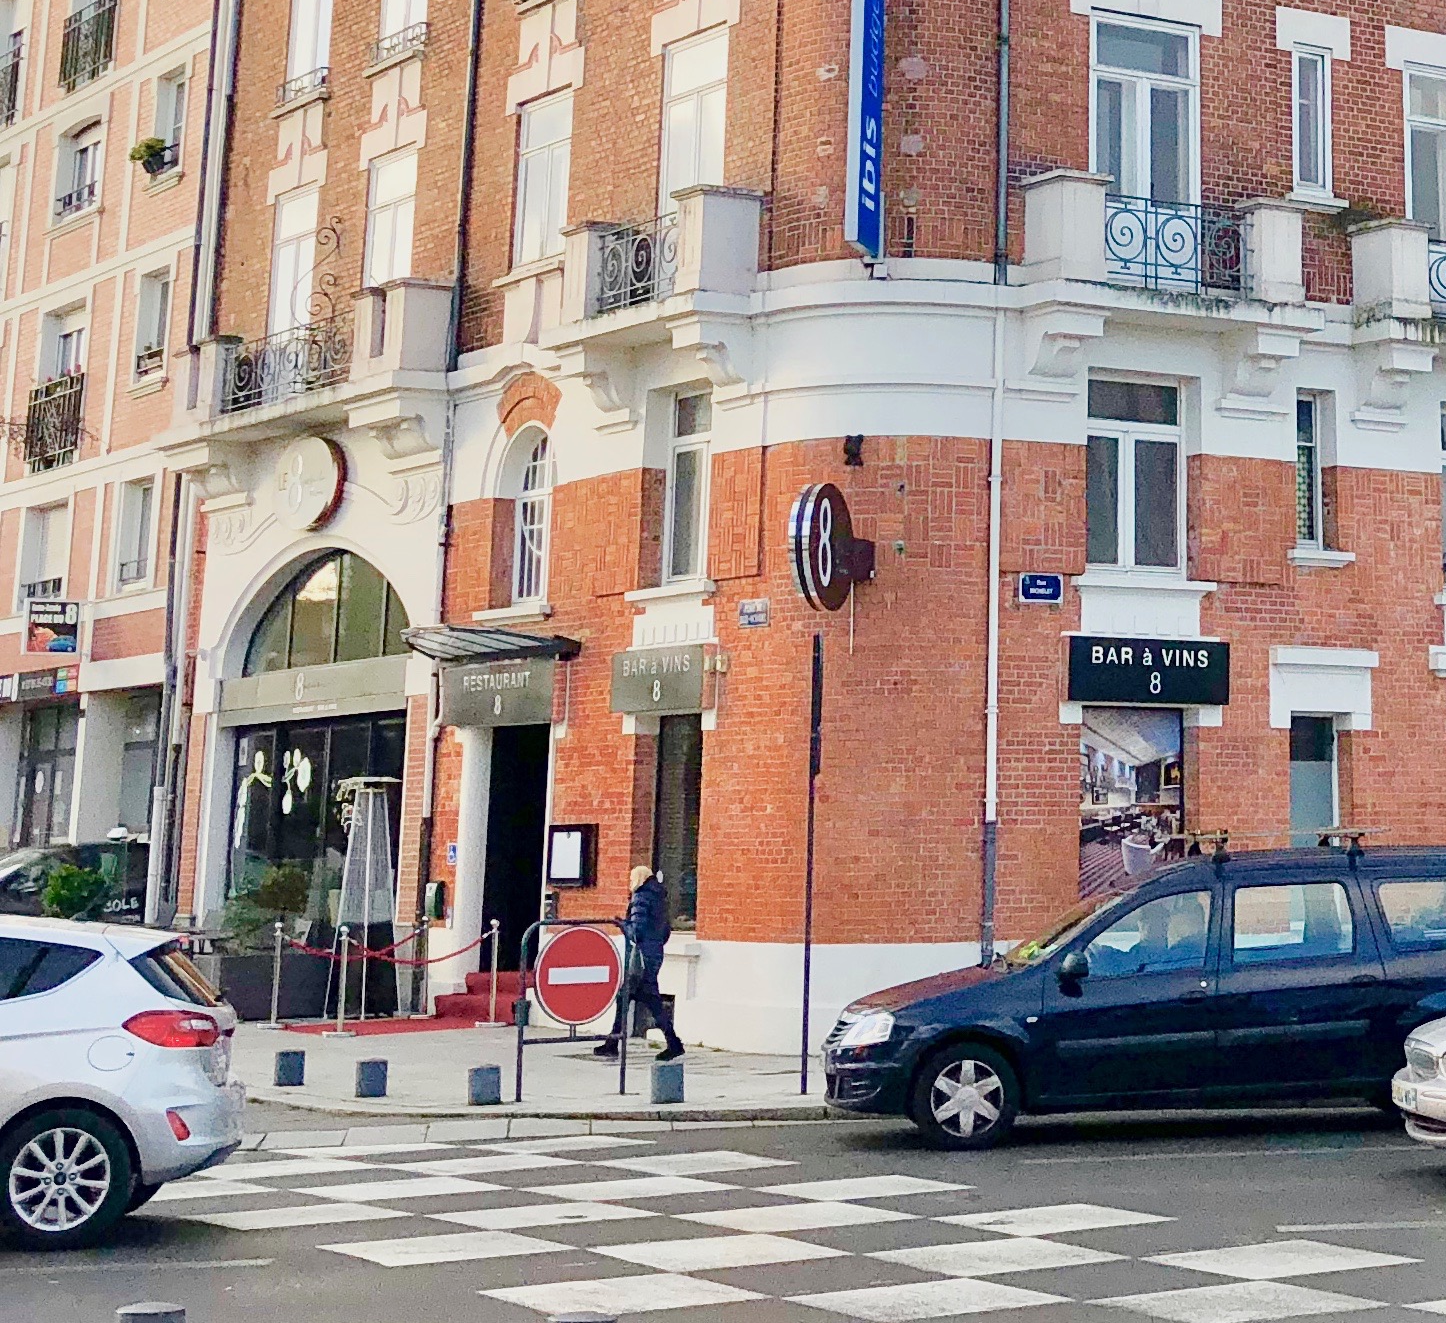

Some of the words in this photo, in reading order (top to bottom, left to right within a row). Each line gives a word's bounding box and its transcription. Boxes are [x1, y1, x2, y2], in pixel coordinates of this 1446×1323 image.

[861, 115, 877, 212] ibis
[818, 497, 832, 588] 8
[64, 603, 78, 625] 8
[622, 659, 645, 676] BAR
[661, 655, 691, 673] VINS
[1091, 645, 1133, 665] BAR
[1142, 647, 1153, 666] à
[1161, 648, 1209, 668] VINS
[295, 672, 305, 701] 8
[463, 671, 531, 692] RESTAURANT
[651, 679, 661, 702] 8
[1150, 671, 1162, 694] 8
[493, 694, 502, 715] 8
